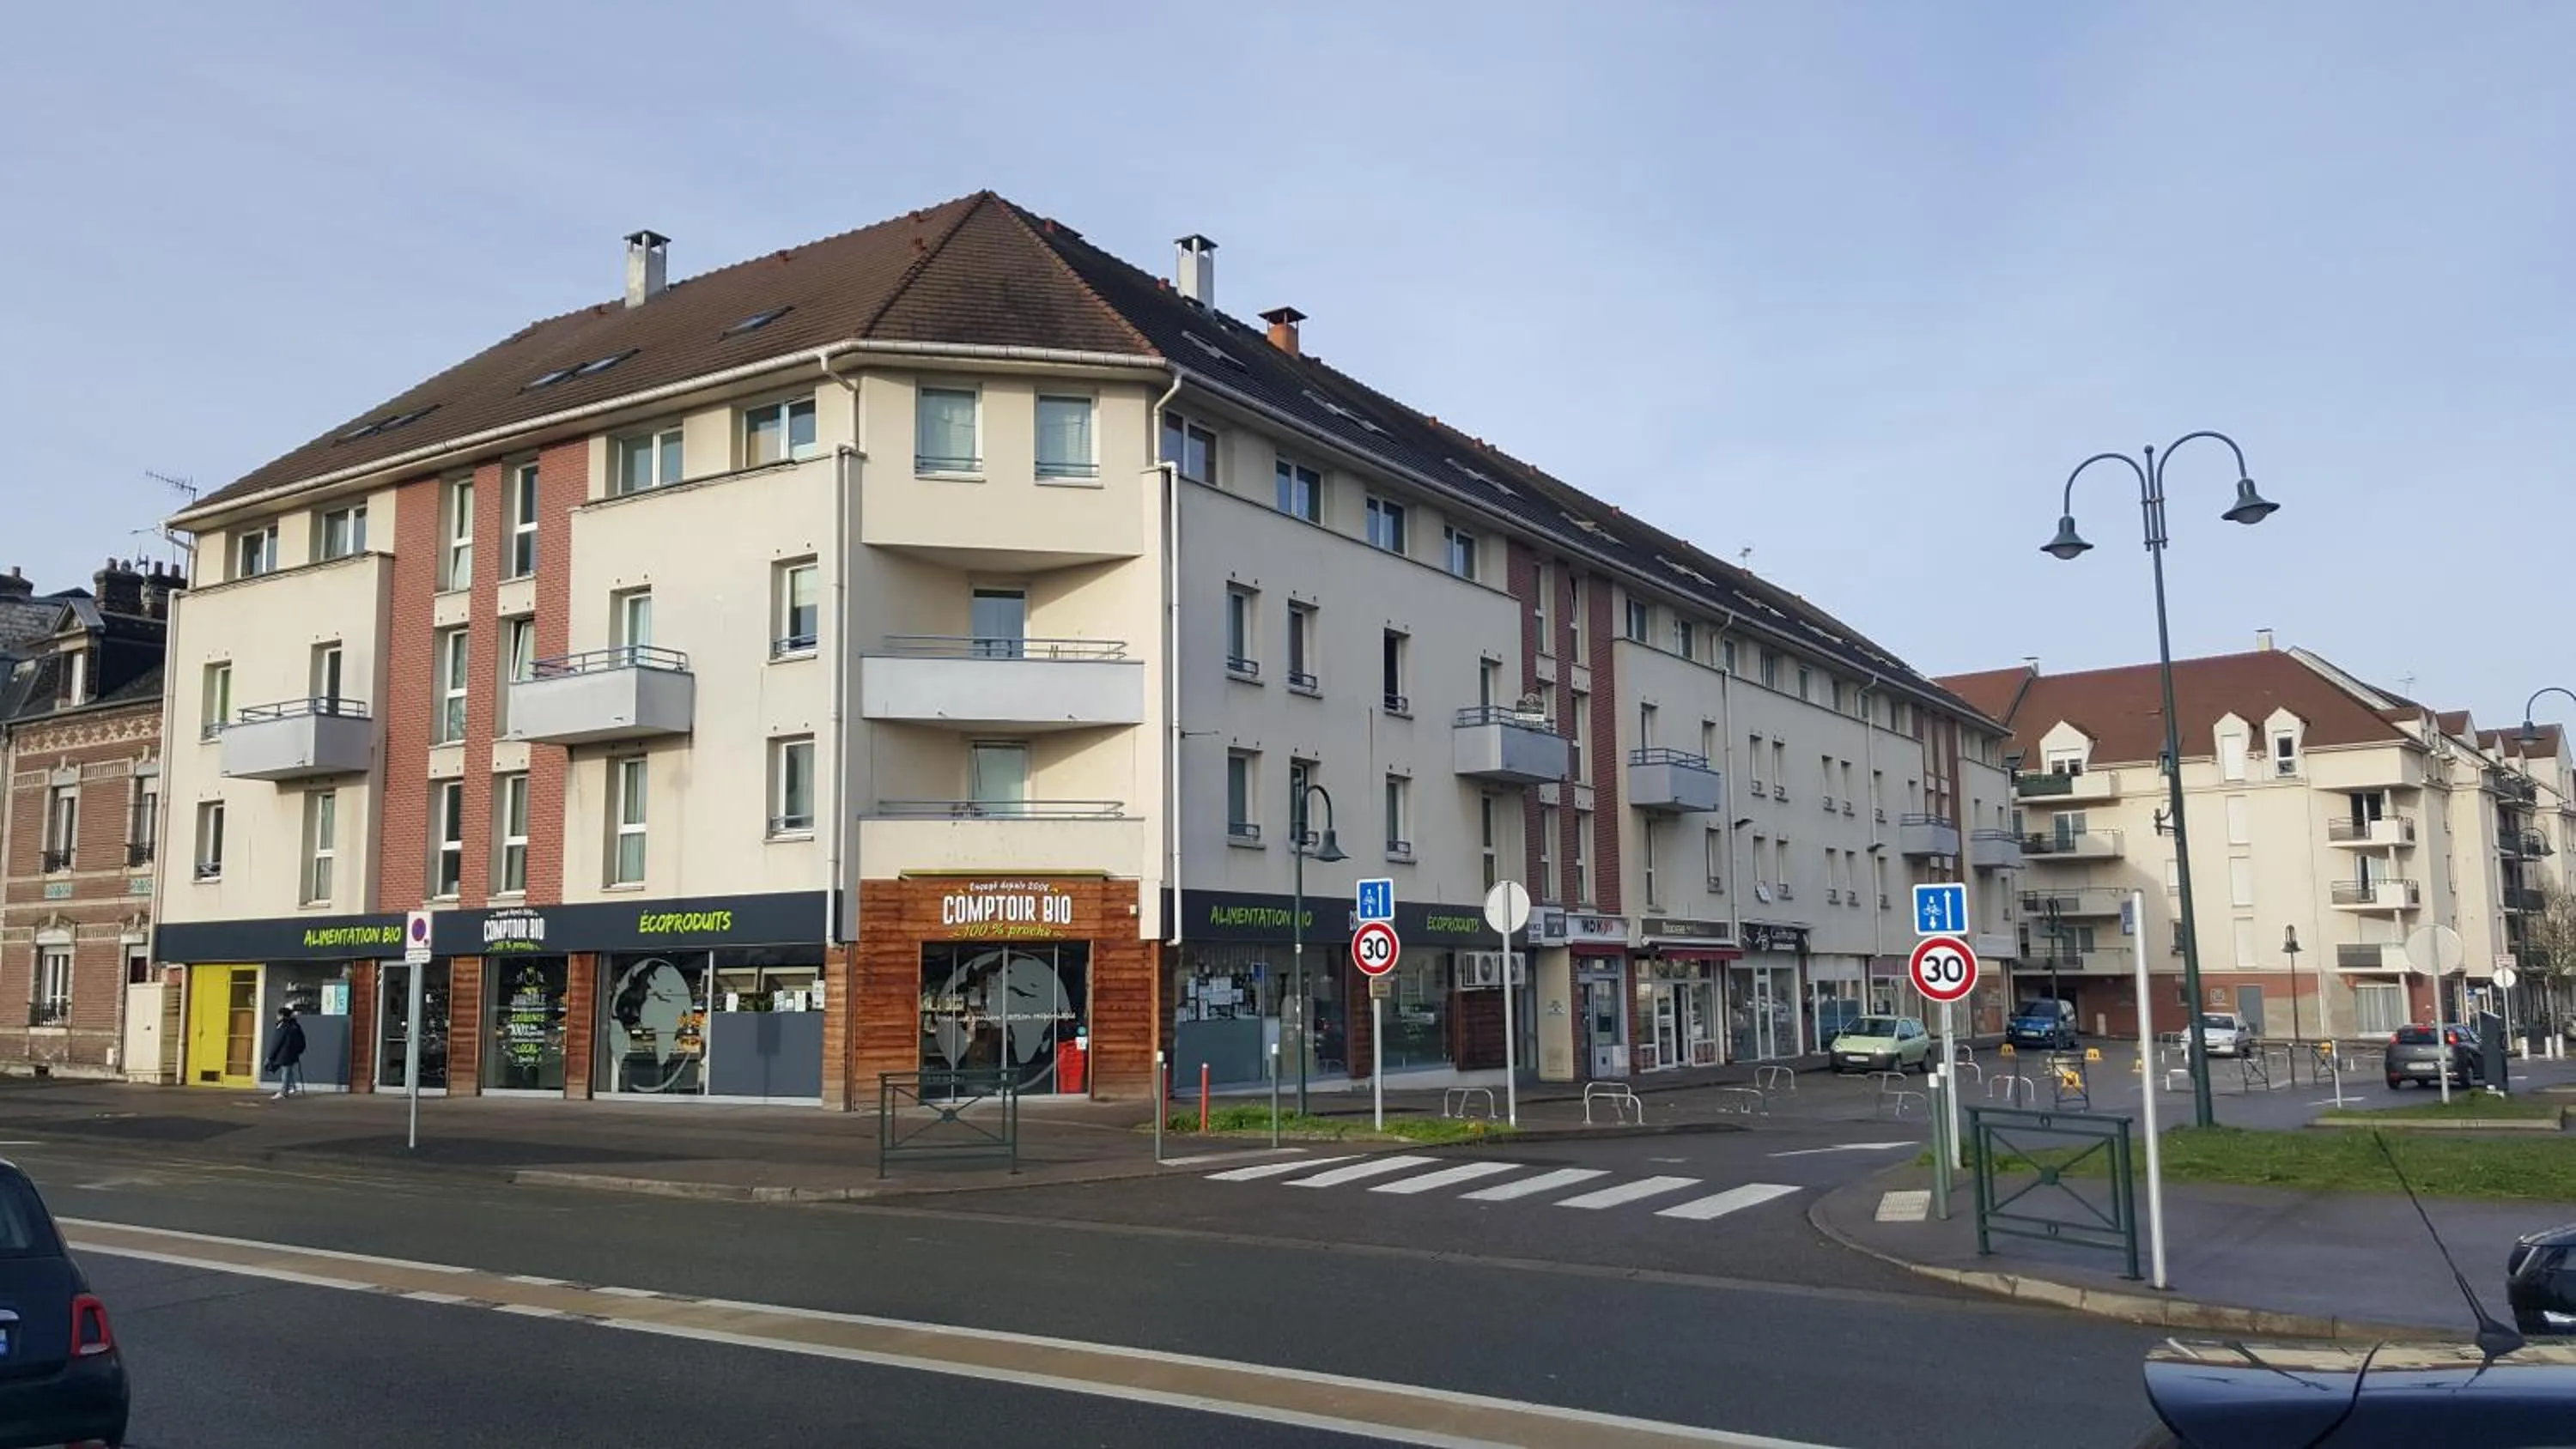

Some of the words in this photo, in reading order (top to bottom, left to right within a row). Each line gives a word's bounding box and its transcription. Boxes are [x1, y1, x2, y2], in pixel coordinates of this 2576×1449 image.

[639, 909, 732, 934] ÉCOPRODUITS
[943, 895, 1036, 925] COMPTOIR
[1043, 895, 1072, 925] BIO
[1210, 906, 1291, 928] ALIMENTATION
[303, 926, 380, 948] ALIMENTATION
[382, 926, 402, 944] BIO
[483, 918, 528, 943] COMPTOIR
[529, 917, 545, 941] BIO
[963, 925, 987, 937] 100
[1362, 937, 1388, 960] 30
[1924, 955, 1964, 983] 30
